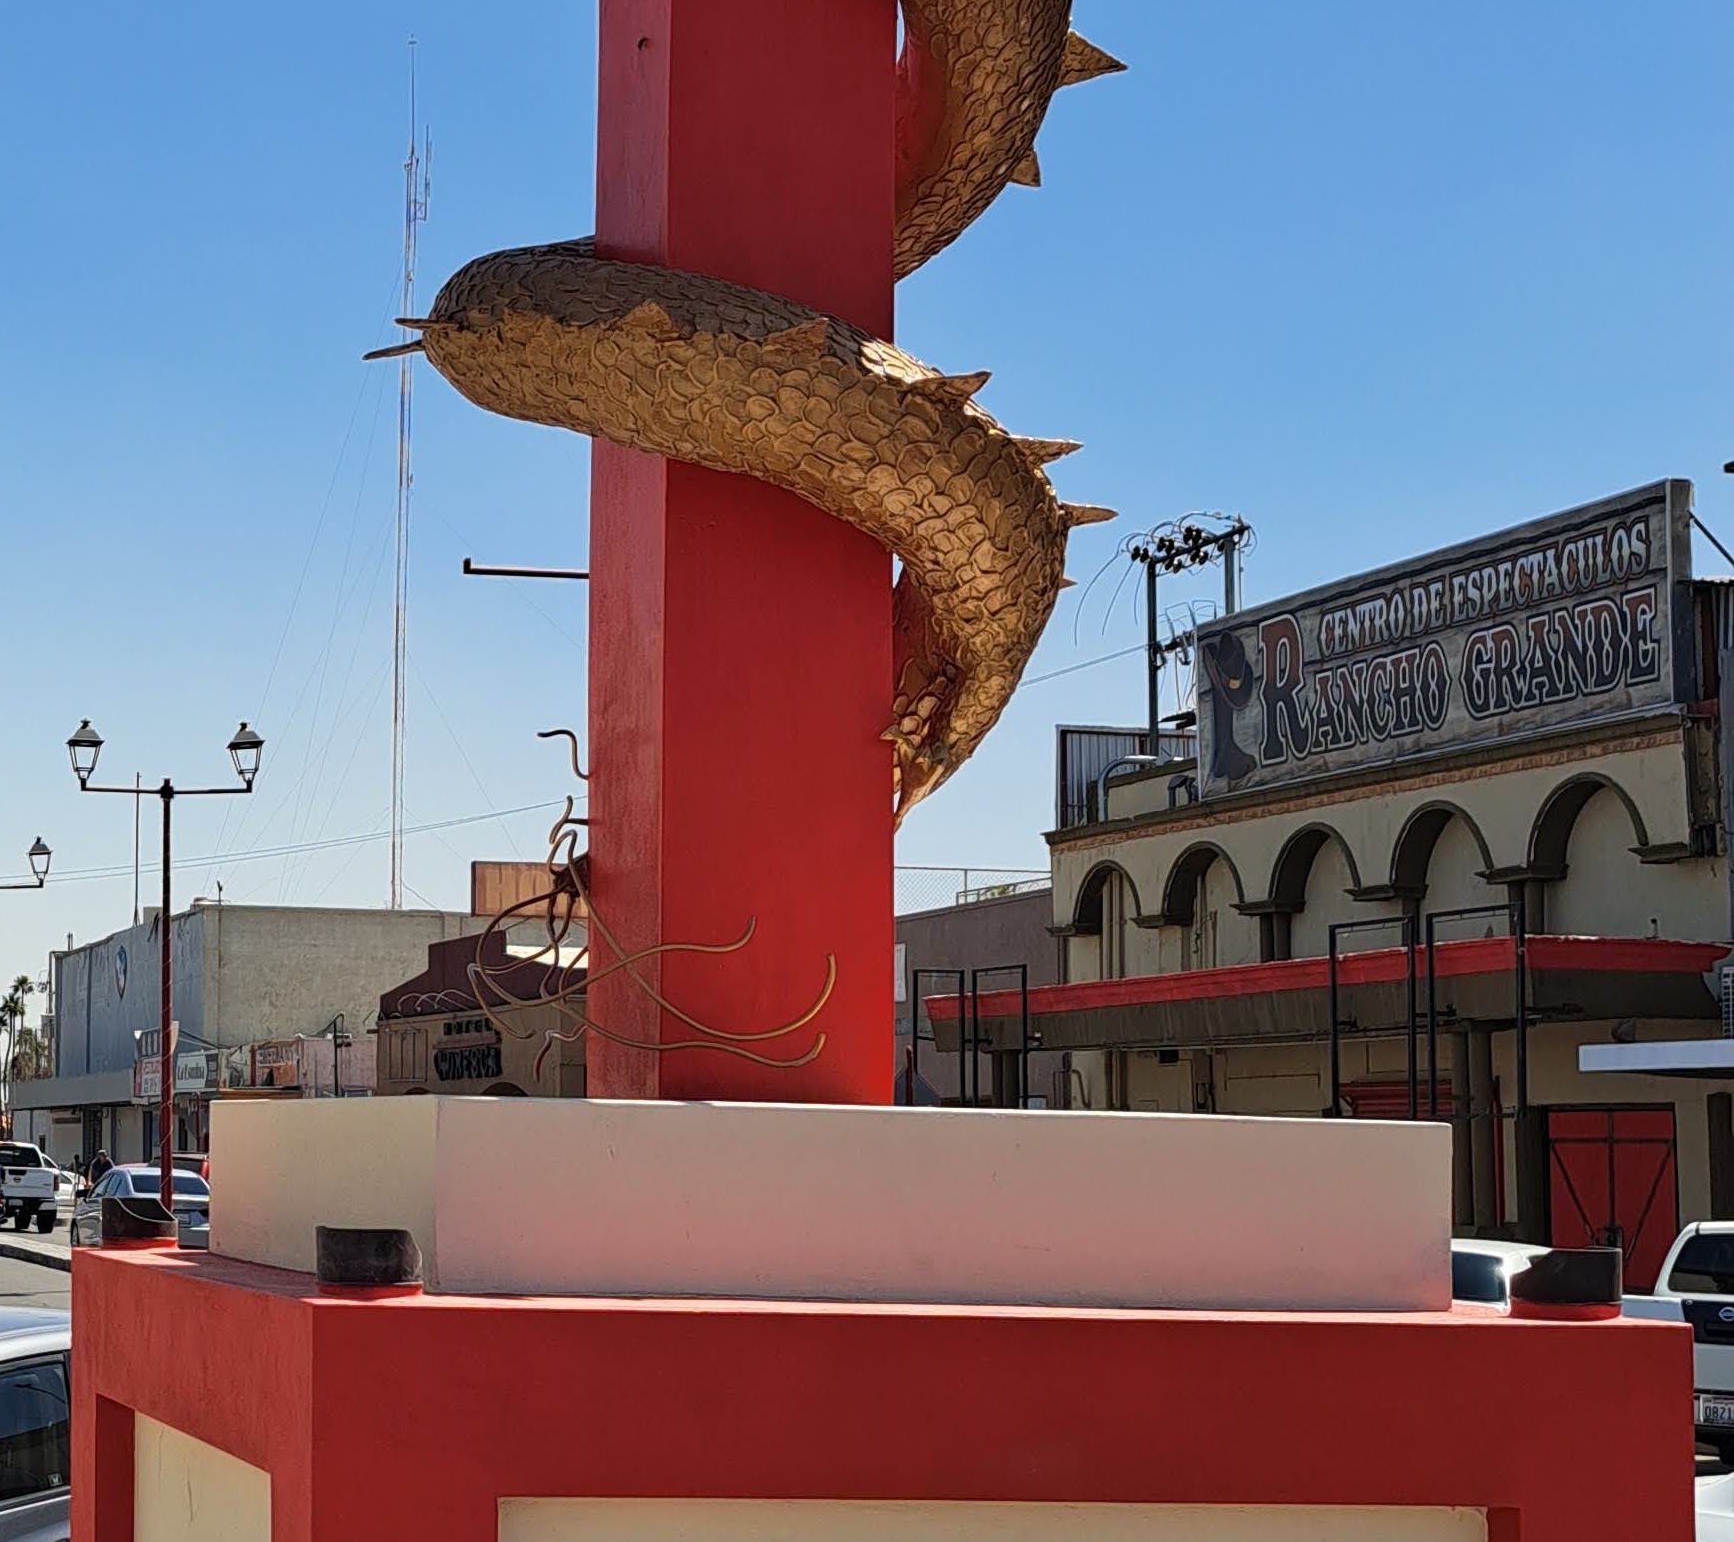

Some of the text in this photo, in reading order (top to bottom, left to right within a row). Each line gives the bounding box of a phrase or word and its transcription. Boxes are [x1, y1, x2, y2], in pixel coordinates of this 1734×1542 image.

[1320, 521, 1650, 657] CENTRO DE ESPECTACULOS
[1260, 587, 1660, 765] RANCHO GRANDE
